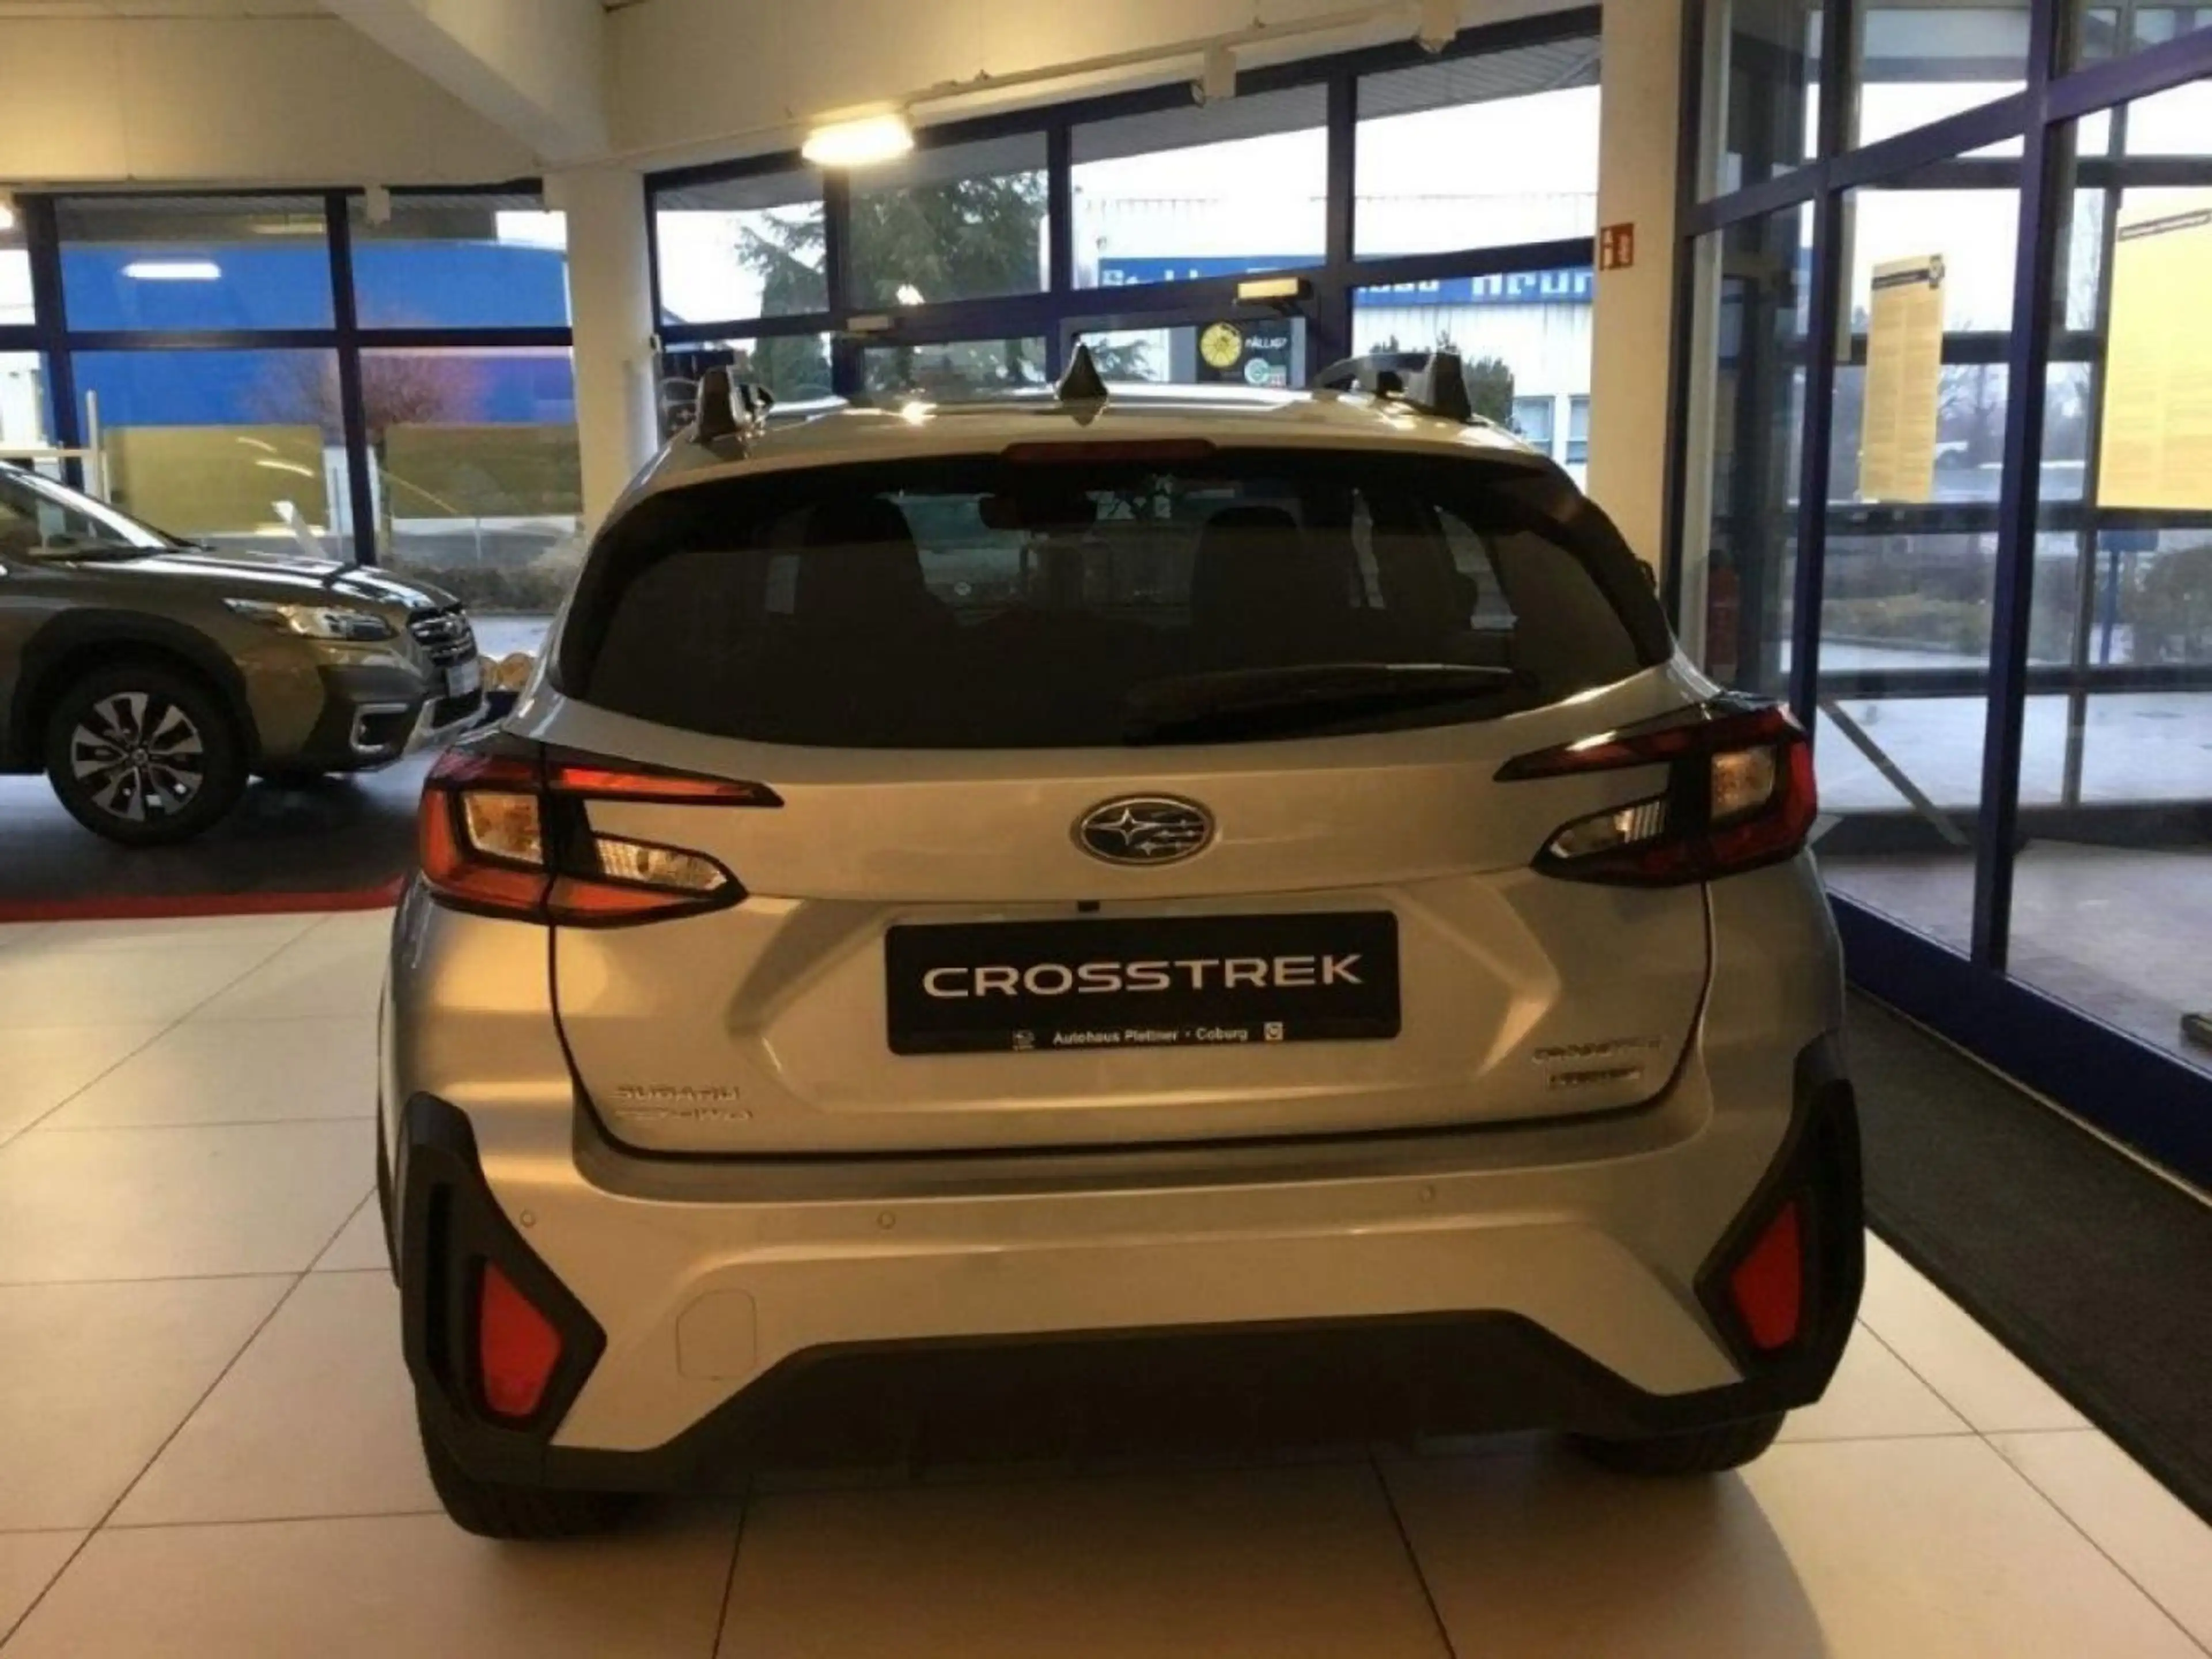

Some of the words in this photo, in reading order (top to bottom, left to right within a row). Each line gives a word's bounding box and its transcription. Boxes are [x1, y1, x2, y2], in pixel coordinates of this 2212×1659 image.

[922, 954, 1363, 998] CROSSTREK
[1053, 1031, 1120, 1046] Autohaus
[1196, 1027, 1247, 1041] Coburg
